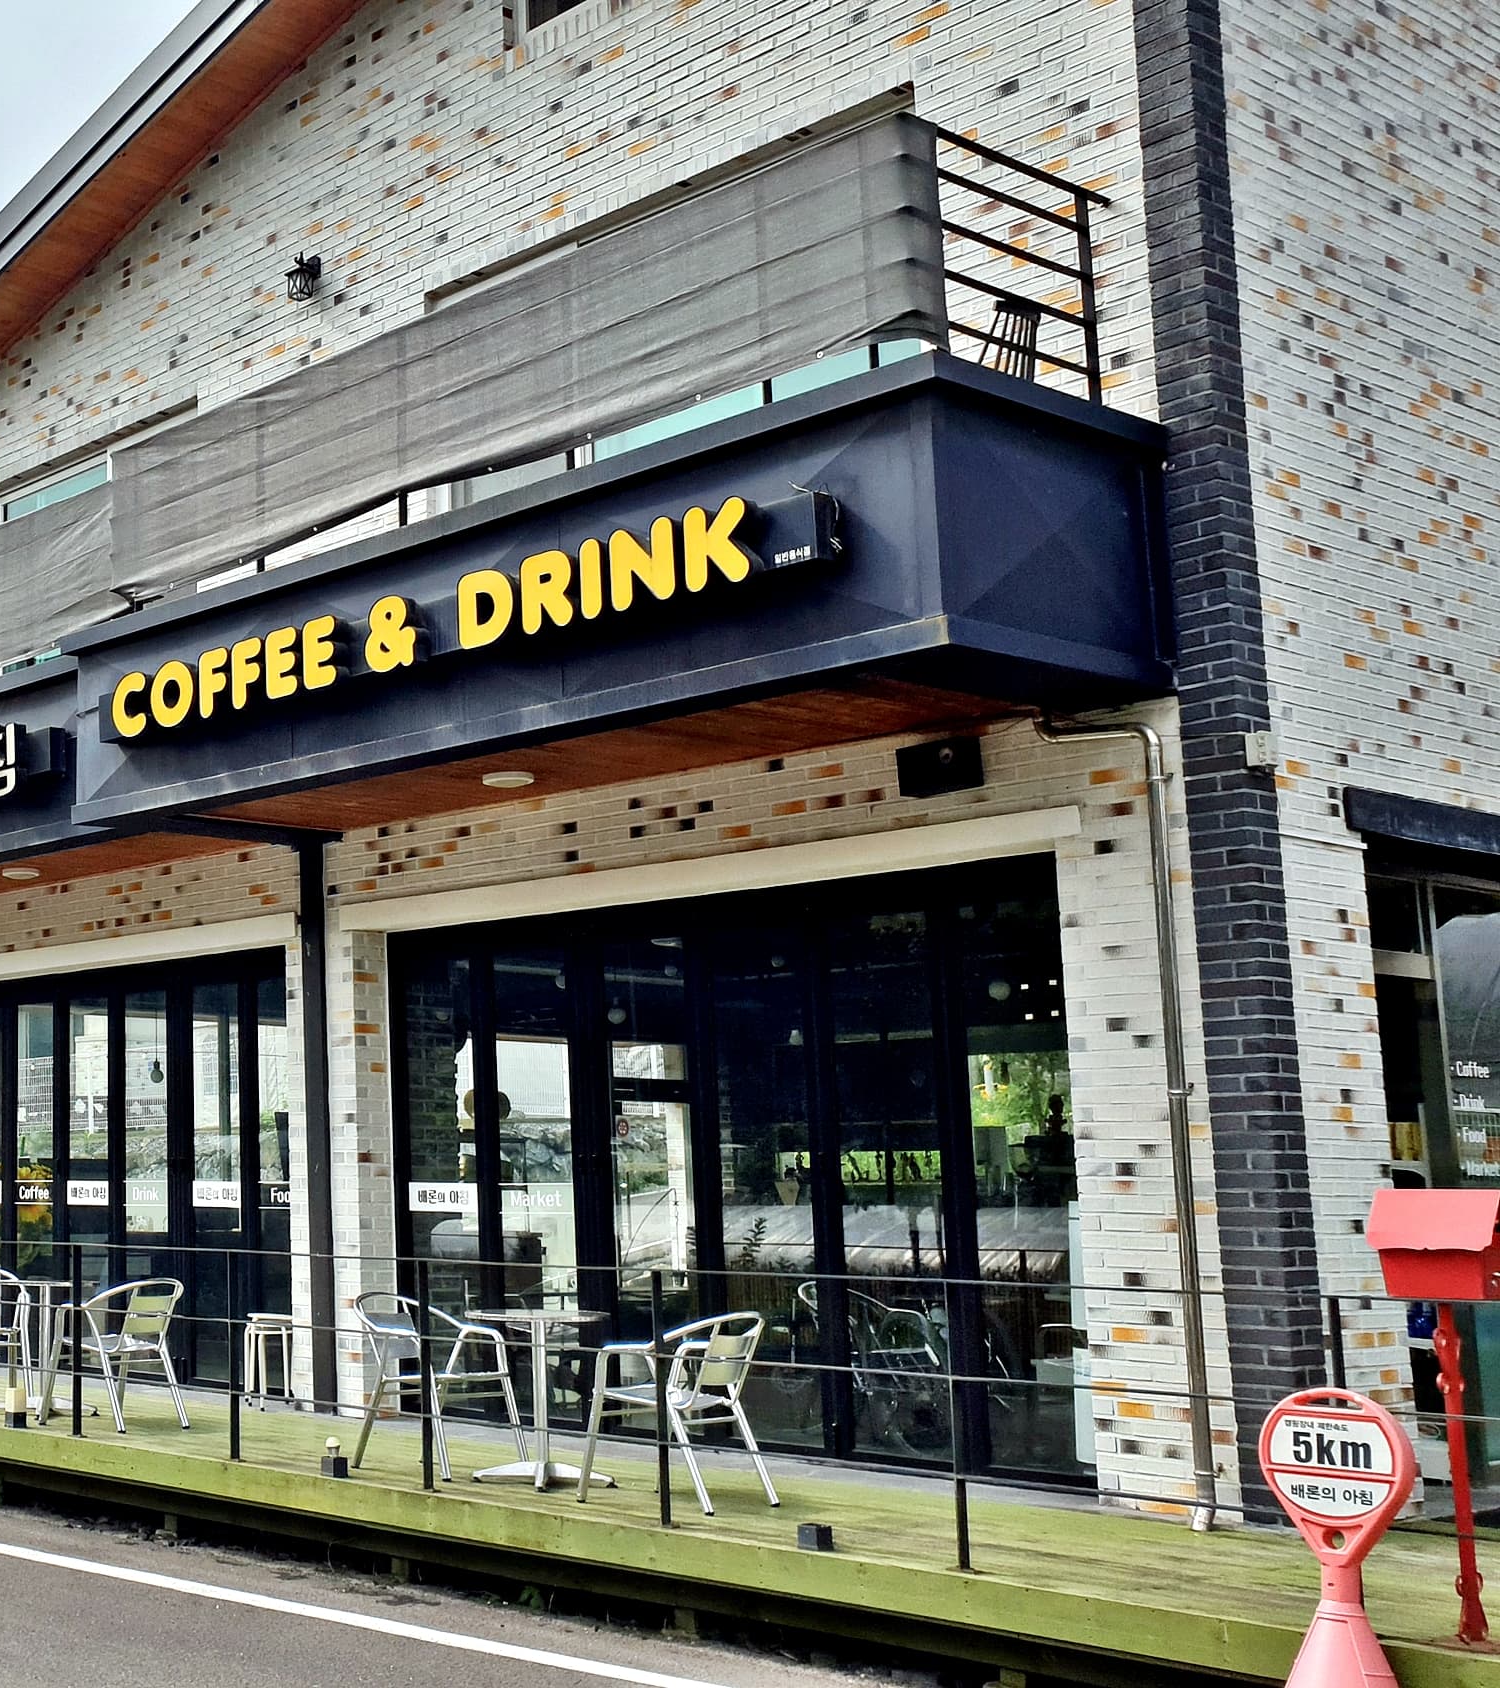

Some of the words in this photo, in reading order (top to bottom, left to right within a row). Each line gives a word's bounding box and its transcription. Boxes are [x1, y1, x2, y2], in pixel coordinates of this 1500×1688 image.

[111, 615, 338, 738] COFFEE
[364, 595, 417, 673] &
[457, 495, 751, 649] DRINK
[1456, 1060, 1490, 1078] Coffee
[1459, 1093, 1485, 1110] Drink
[1462, 1127, 1487, 1143] Food
[18, 1185, 50, 1200] Coffee
[132, 1186, 159, 1201] Drink
[270, 1187, 290, 1204] Foo
[417, 1190, 446, 1204] 배론의
[510, 1190, 562, 1208] Market
[1292, 1431, 1373, 1469] 5km
[1290, 1484, 1336, 1502] 배론의
[1342, 1489, 1373, 1506] 아침
